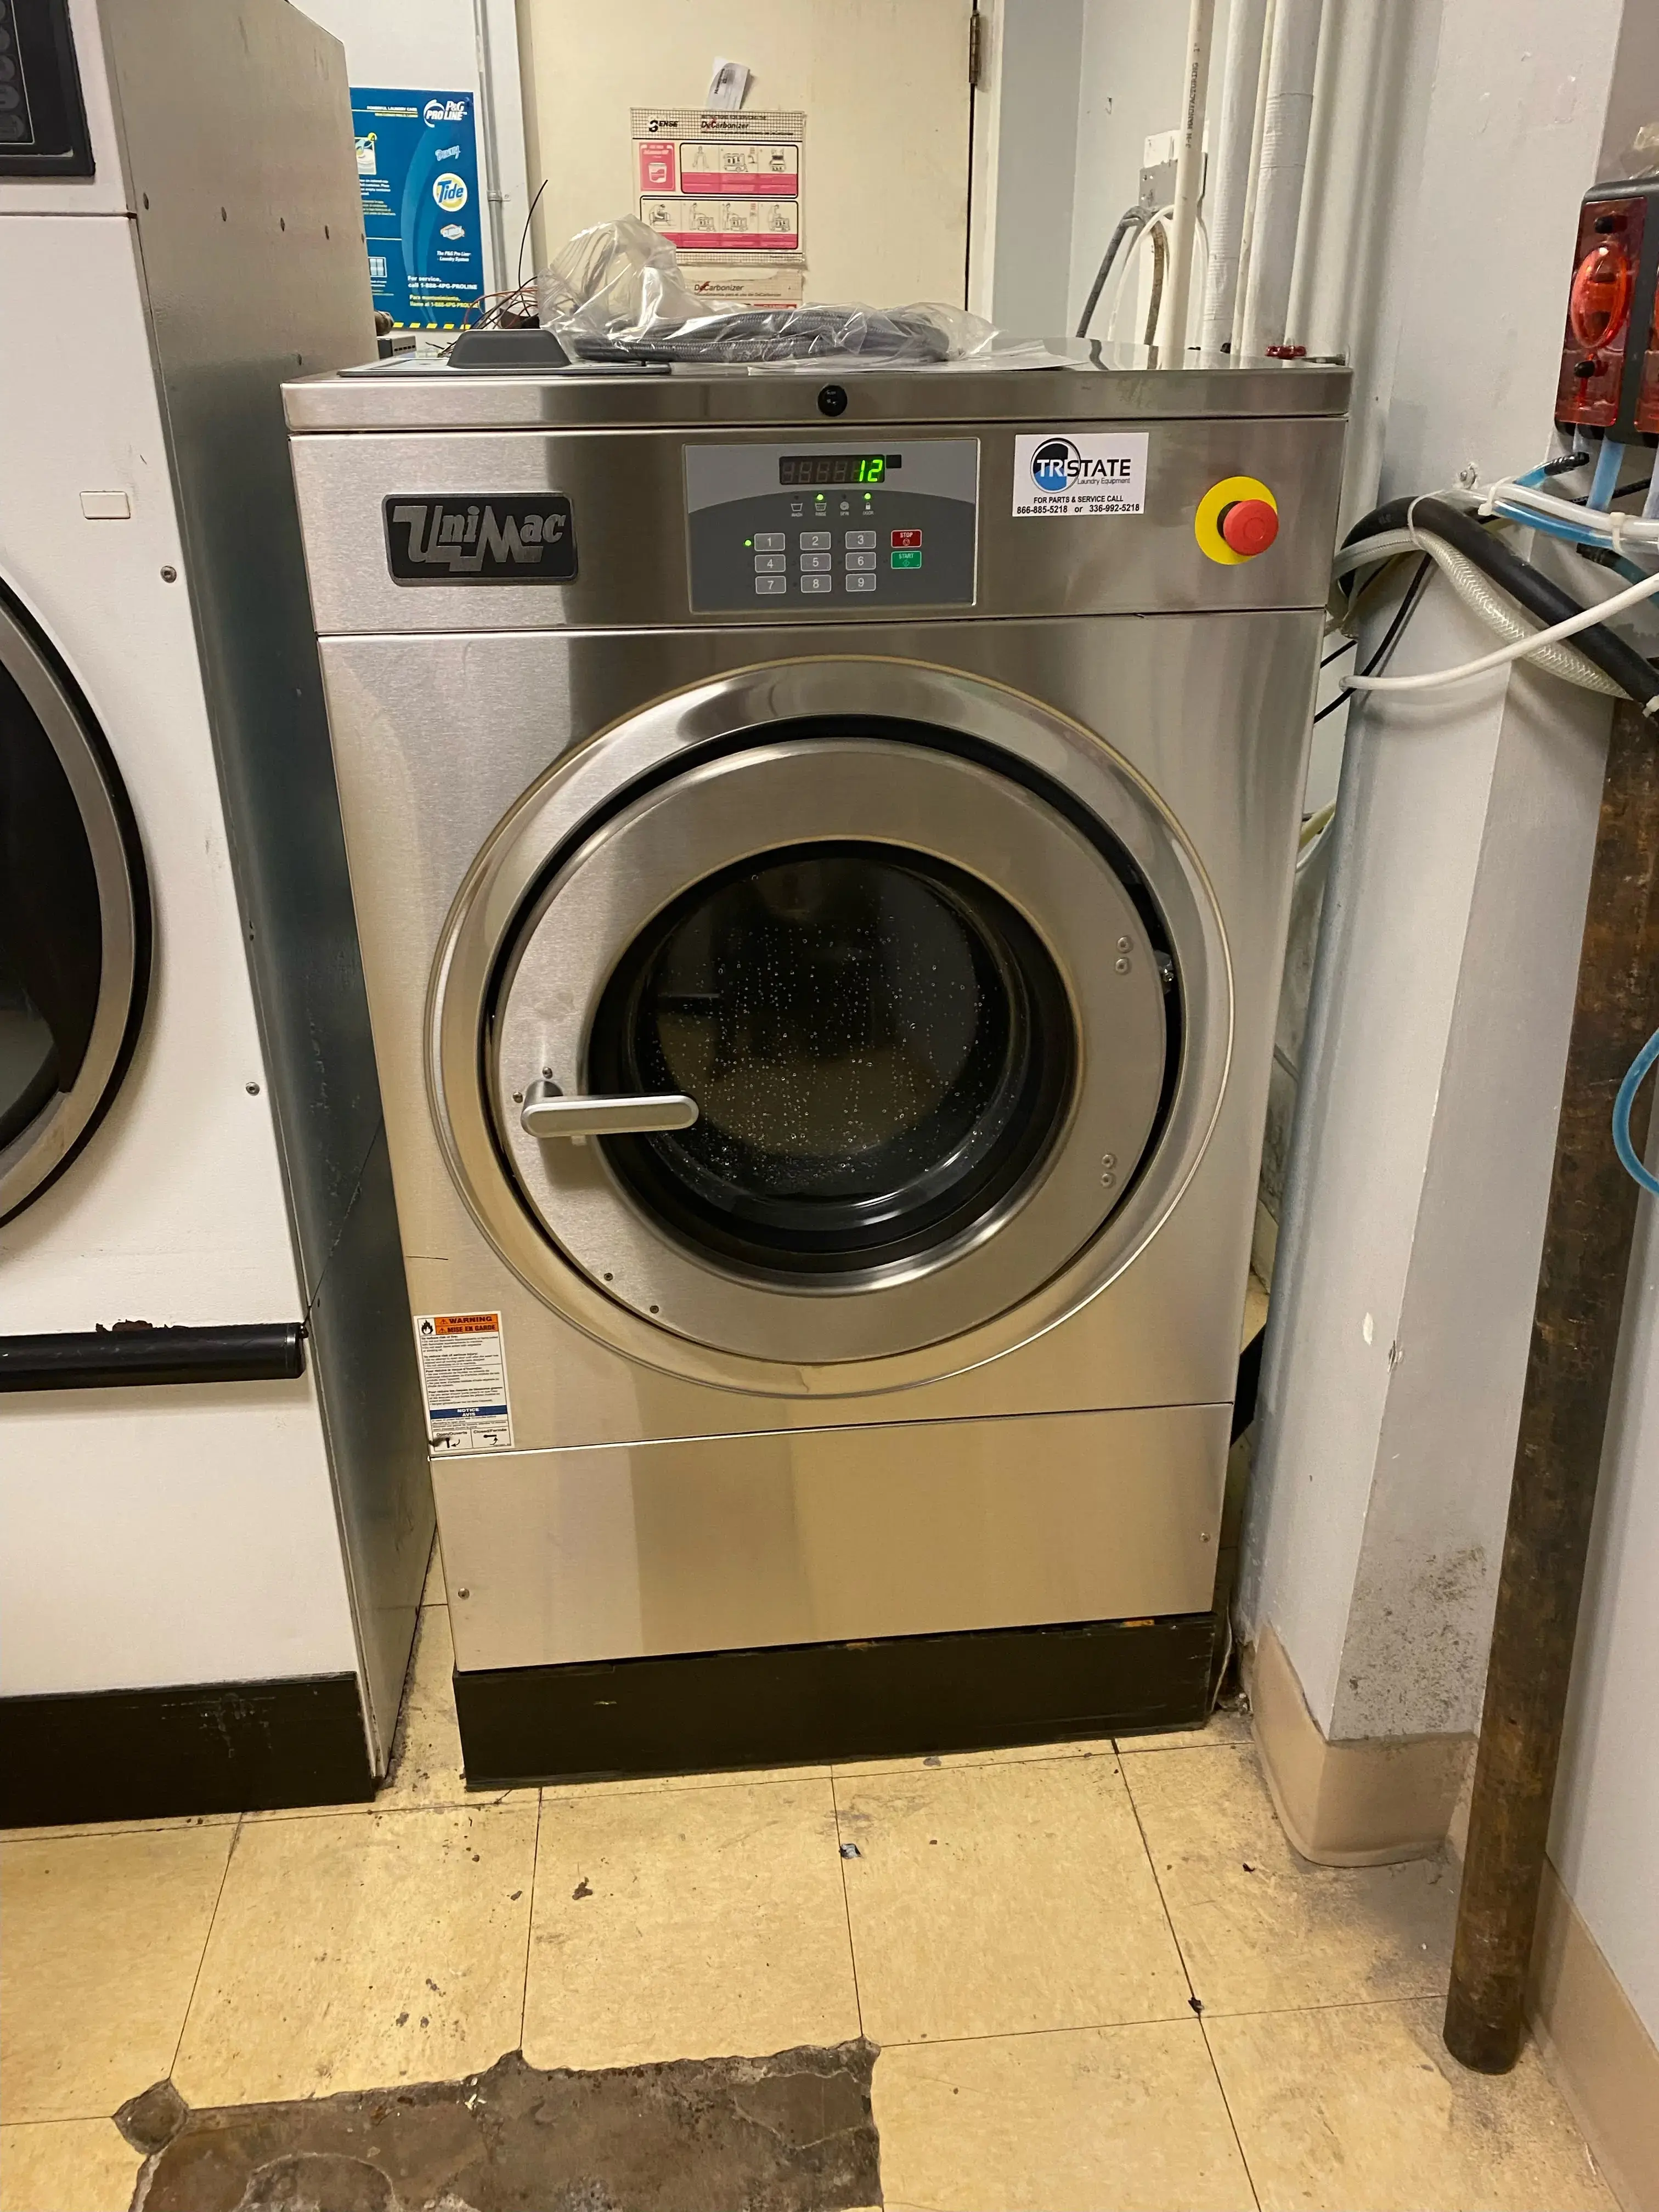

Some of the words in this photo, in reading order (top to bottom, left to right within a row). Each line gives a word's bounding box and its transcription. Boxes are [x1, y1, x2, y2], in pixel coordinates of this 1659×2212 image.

[1187, 62, 1199, 129] MANUFACTURING
[445, 101, 465, 111] P&G
[426, 110, 443, 120] PRO
[443, 111, 463, 121] LINE
[701, 121, 749, 129] DeCarbonizer
[437, 180, 464, 203] Tide
[859, 459, 883, 482] 12
[1017, 505, 1068, 514] 866-885-5218
[1089, 504, 1140, 512] 336-992-5218
[393, 505, 567, 572] UniMac
[768, 537, 772, 547] 1
[811, 536, 819, 546] 2
[857, 535, 864, 545] 3
[766, 558, 774, 569] 4
[812, 557, 819, 567] 5
[857, 556, 864, 566] 6
[768, 580, 774, 590] 7
[812, 579, 819, 589] 8
[857, 578, 865, 588] 9
